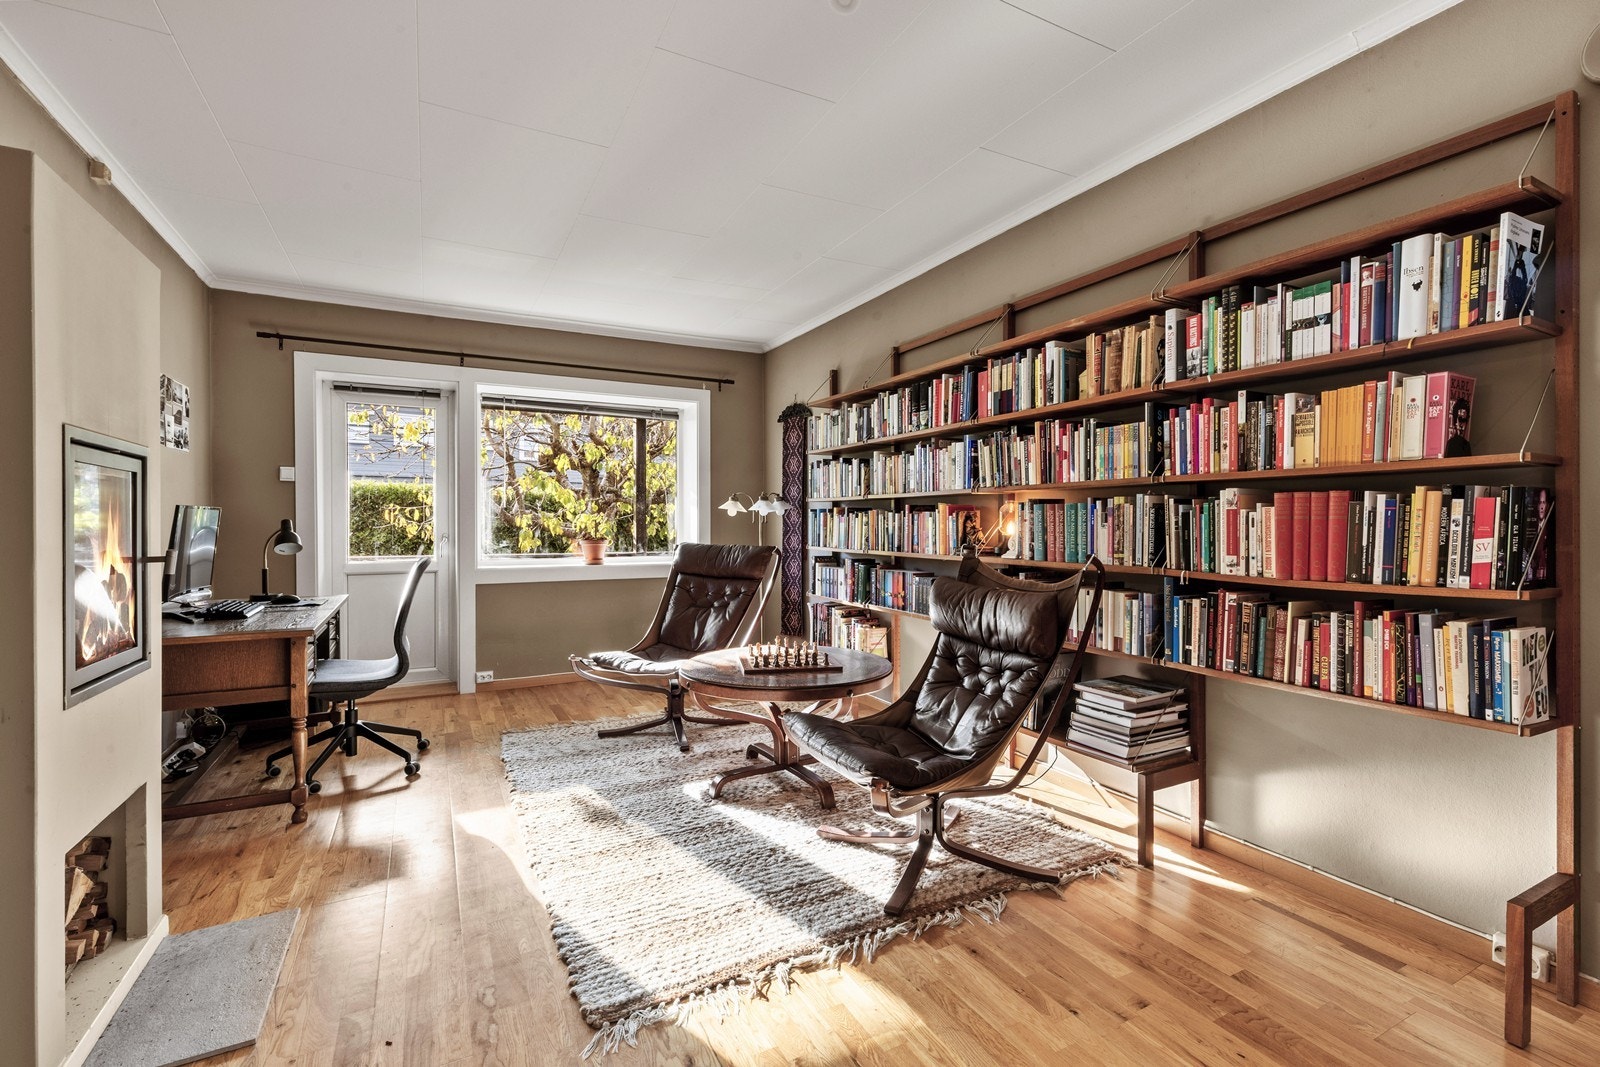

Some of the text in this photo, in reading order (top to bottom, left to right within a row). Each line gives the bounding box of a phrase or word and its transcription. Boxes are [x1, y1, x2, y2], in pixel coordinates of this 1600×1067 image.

[1403, 265, 1424, 276] Ibsen
[1167, 331, 1175, 362] Sapiens
[1426, 522, 1434, 572] FOLKESOSIALISTEN
[1475, 542, 1491, 553] SV
[1321, 656, 1329, 680] CUBA
